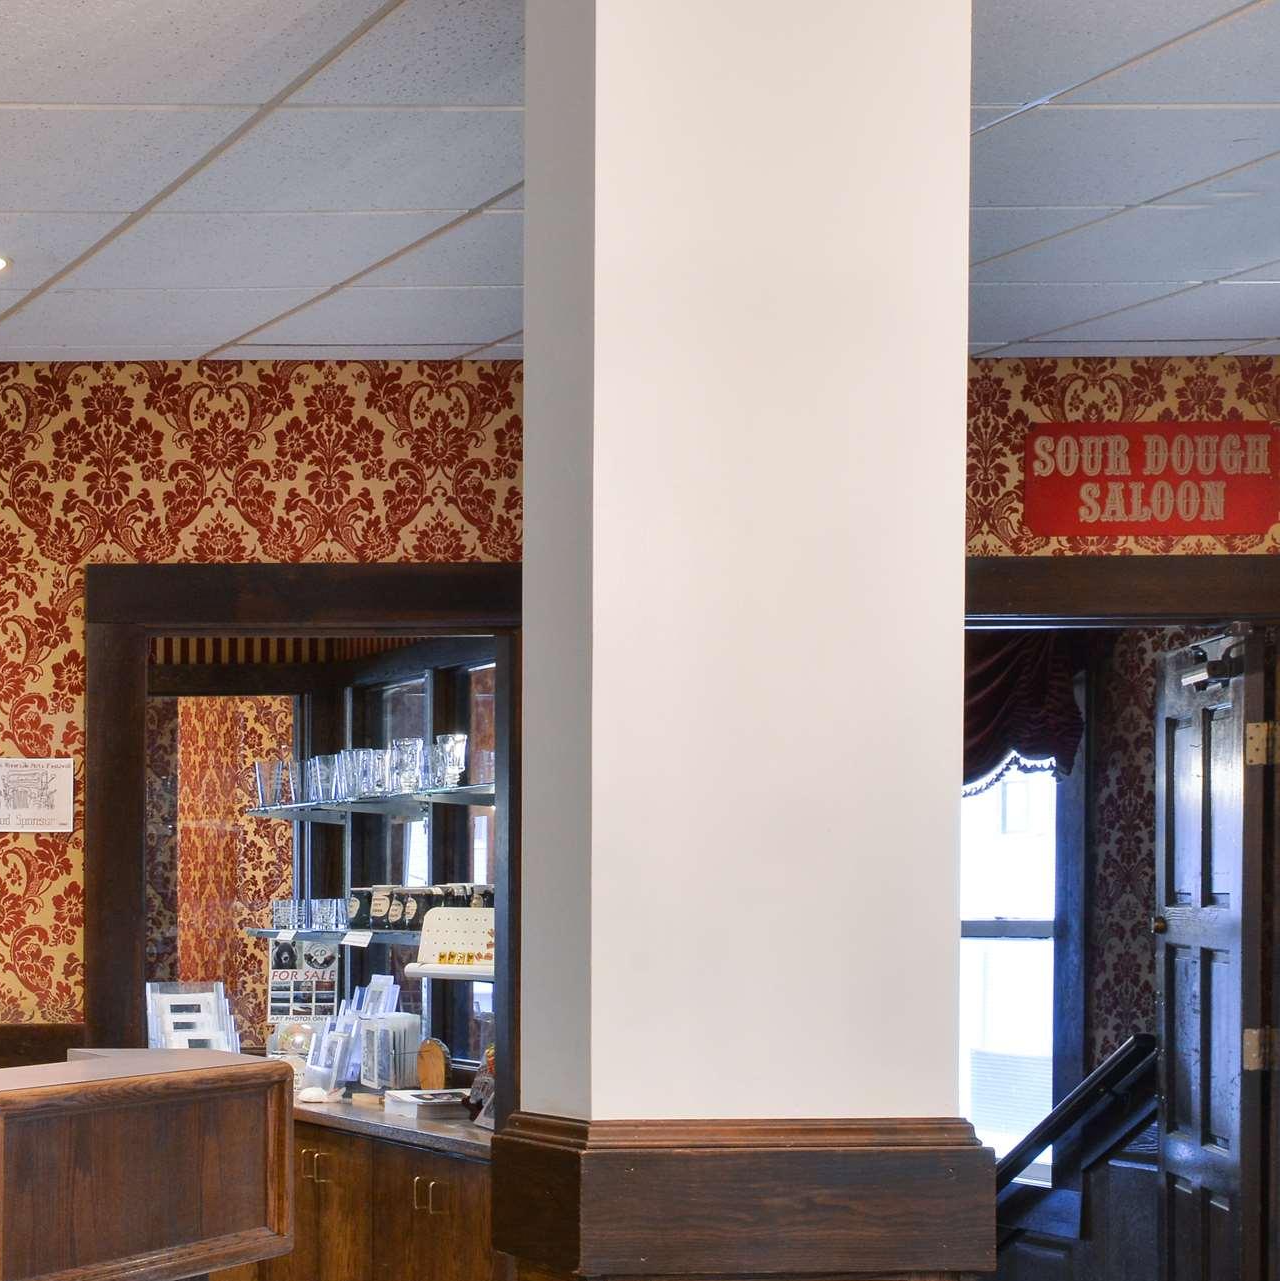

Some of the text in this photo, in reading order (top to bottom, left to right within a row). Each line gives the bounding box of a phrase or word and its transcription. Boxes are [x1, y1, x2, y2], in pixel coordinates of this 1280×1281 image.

[1033, 434, 1271, 477] SOUR DOUGH
[1078, 480, 1226, 523] SALOON
[272, 970, 336, 980] FOR SALE
